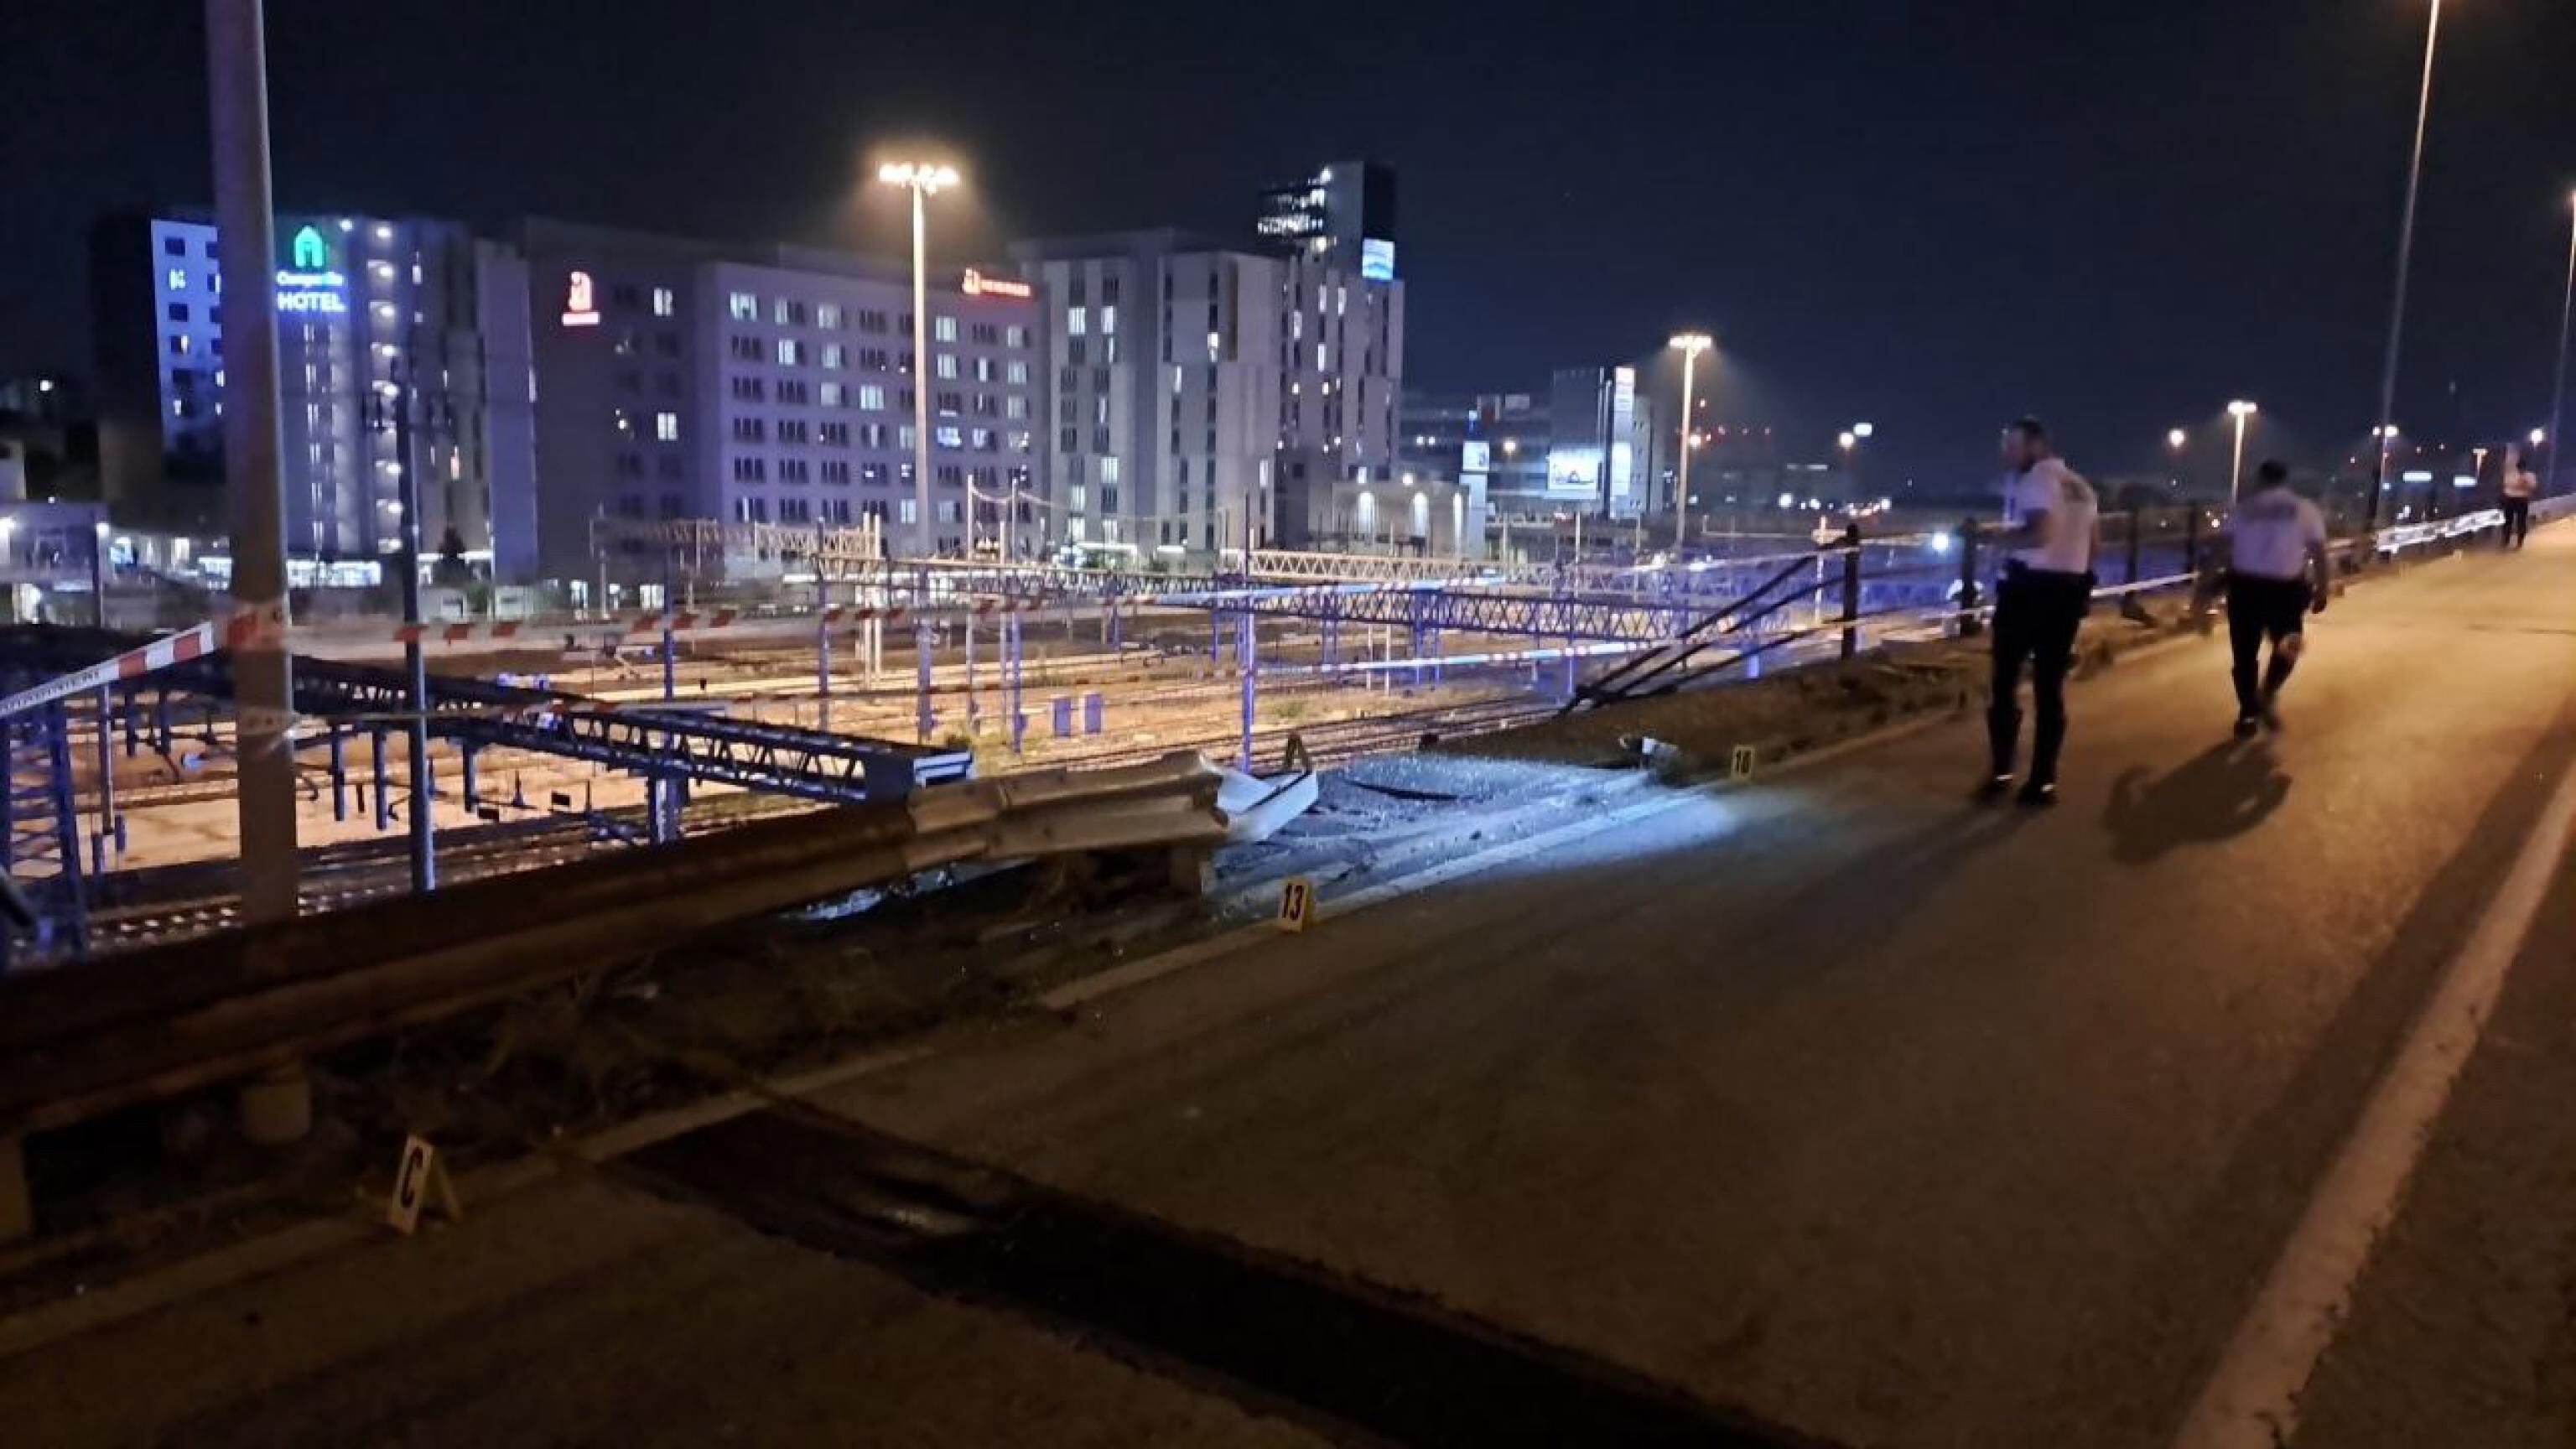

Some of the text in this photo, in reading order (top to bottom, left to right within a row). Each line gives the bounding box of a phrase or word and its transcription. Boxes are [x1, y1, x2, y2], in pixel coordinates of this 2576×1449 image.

[277, 291, 345, 312] HOTEL
[1282, 883, 1303, 921] 13
[400, 1146, 423, 1208] C
